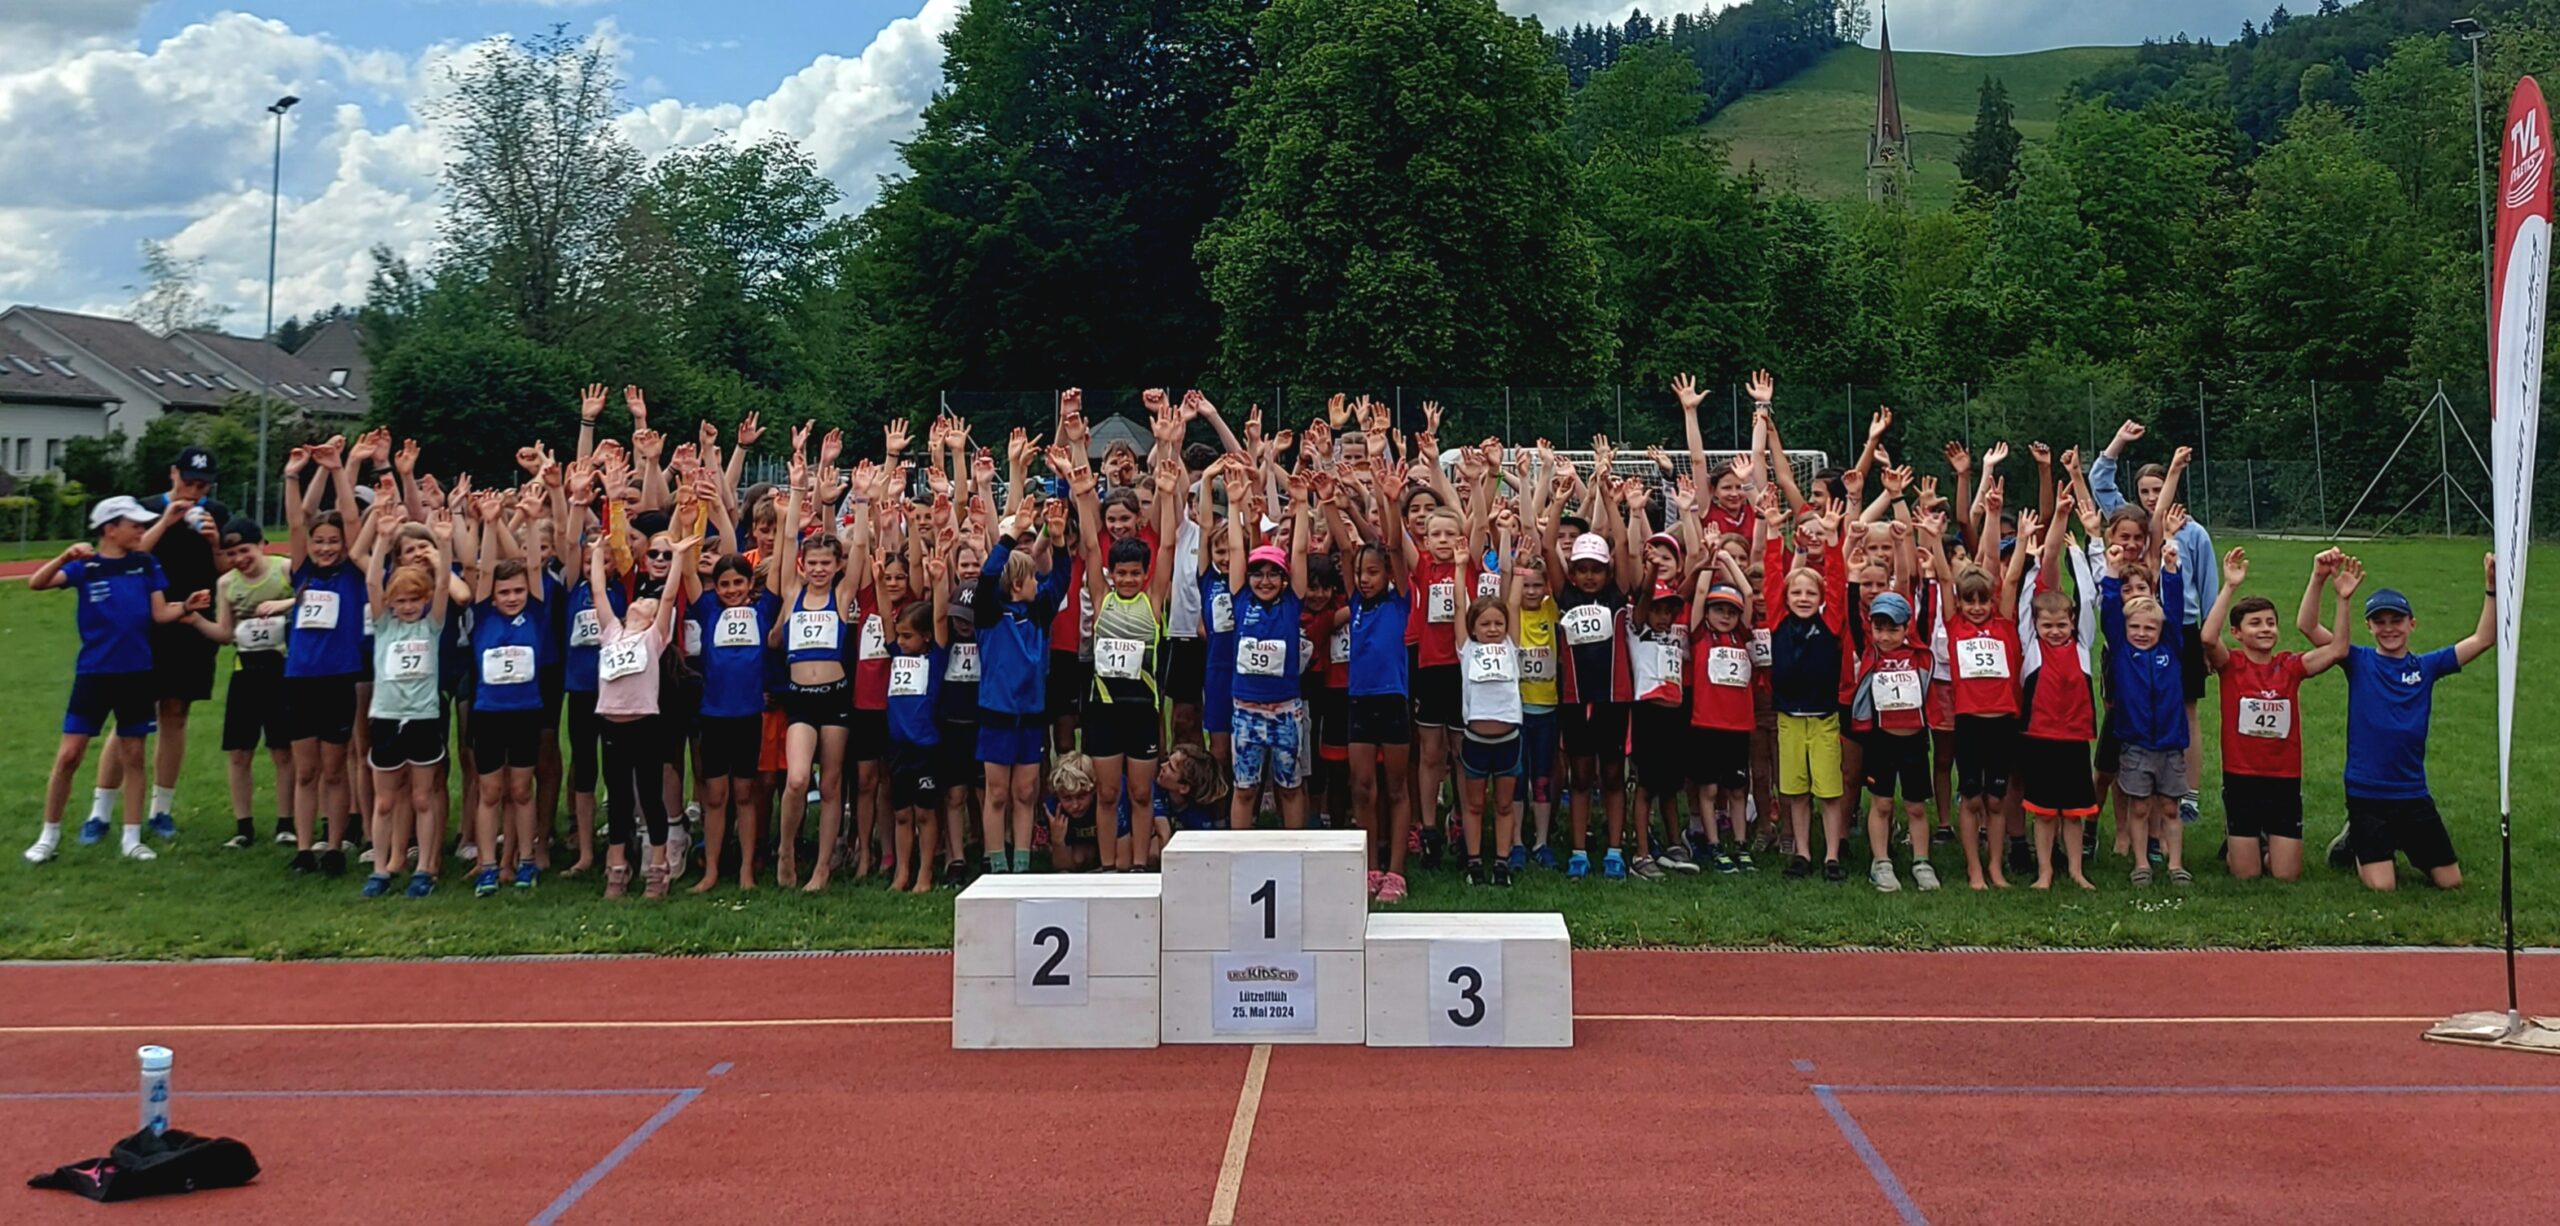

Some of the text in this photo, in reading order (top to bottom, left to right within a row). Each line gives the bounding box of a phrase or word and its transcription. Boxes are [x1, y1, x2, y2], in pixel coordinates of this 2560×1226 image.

[2511, 108, 2540, 167] TVL
[733, 610, 754, 620] UBS
[1580, 605, 1602, 616] UBS
[809, 613, 832, 622] UBS
[580, 623, 599, 637] 86
[728, 622, 747, 635] 82
[803, 625, 823, 638] 67
[1572, 618, 1601, 635] 130
[251, 630, 270, 641] 34
[1115, 641, 1137, 651] UBS
[1256, 641, 1278, 651] UBS
[1486, 646, 1506, 656] UBS
[1979, 641, 2000, 651] UBS
[1528, 648, 1549, 657] UBS
[402, 656, 421, 669] 57
[899, 658, 920, 669] UBS
[962, 659, 971, 671] 4
[1108, 654, 1126, 668] 11
[1251, 653, 1269, 667] 59
[1482, 658, 1501, 670] 51
[1975, 653, 1995, 667] 53
[504, 660, 514, 673] 5
[1524, 661, 1543, 673] 50
[1730, 663, 1738, 675] 2
[894, 672, 911, 685] 52
[1890, 673, 1912, 683] UBS
[1891, 686, 1900, 699] 1
[2263, 703, 2284, 711] UBS
[2255, 714, 2276, 728] 42
[1250, 879, 1276, 939] 1
[1032, 927, 1070, 986] 2
[1447, 966, 1486, 1027] 3
[1232, 1006, 1294, 1018] 25. Mai 2024
